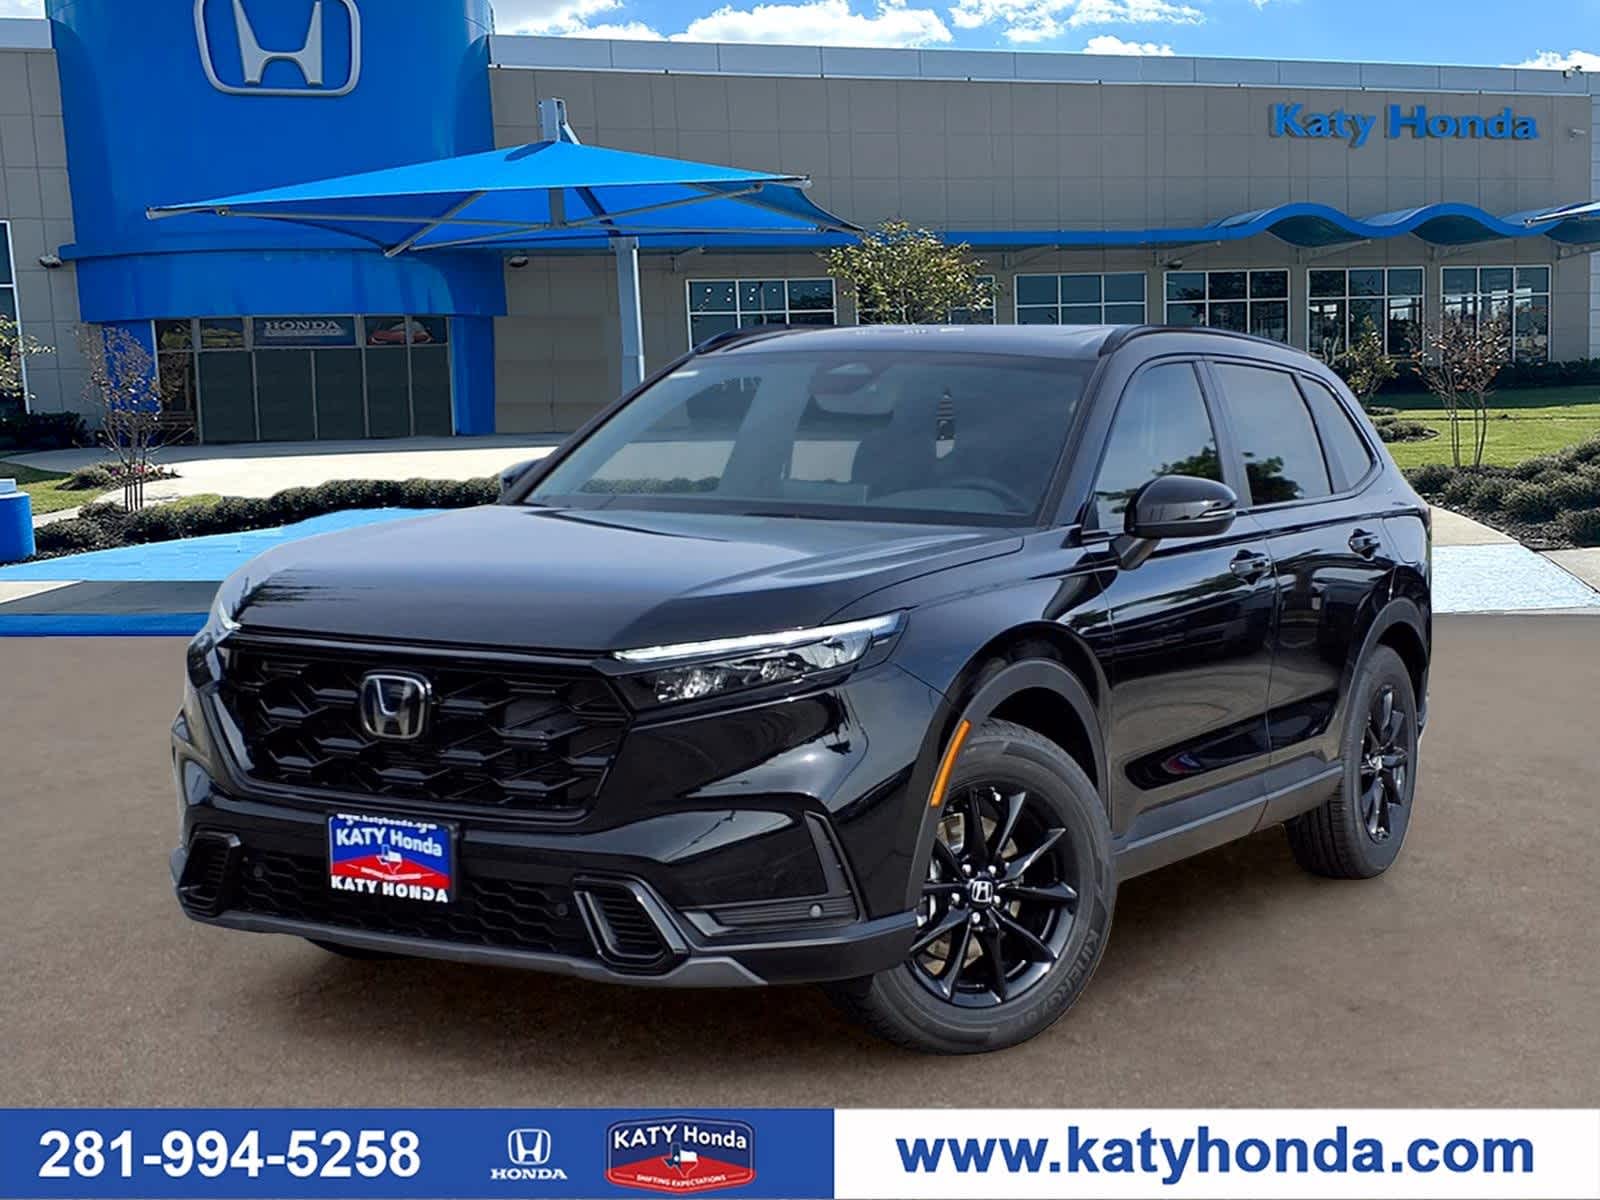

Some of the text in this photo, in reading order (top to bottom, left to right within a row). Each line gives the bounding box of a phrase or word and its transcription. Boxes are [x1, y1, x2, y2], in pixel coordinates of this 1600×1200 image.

[1270, 103, 1540, 148] Katy Honda
[264, 320, 341, 330] HONDA
[335, 827, 443, 857] KATY Honda
[330, 875, 448, 903] KATY HONDA
